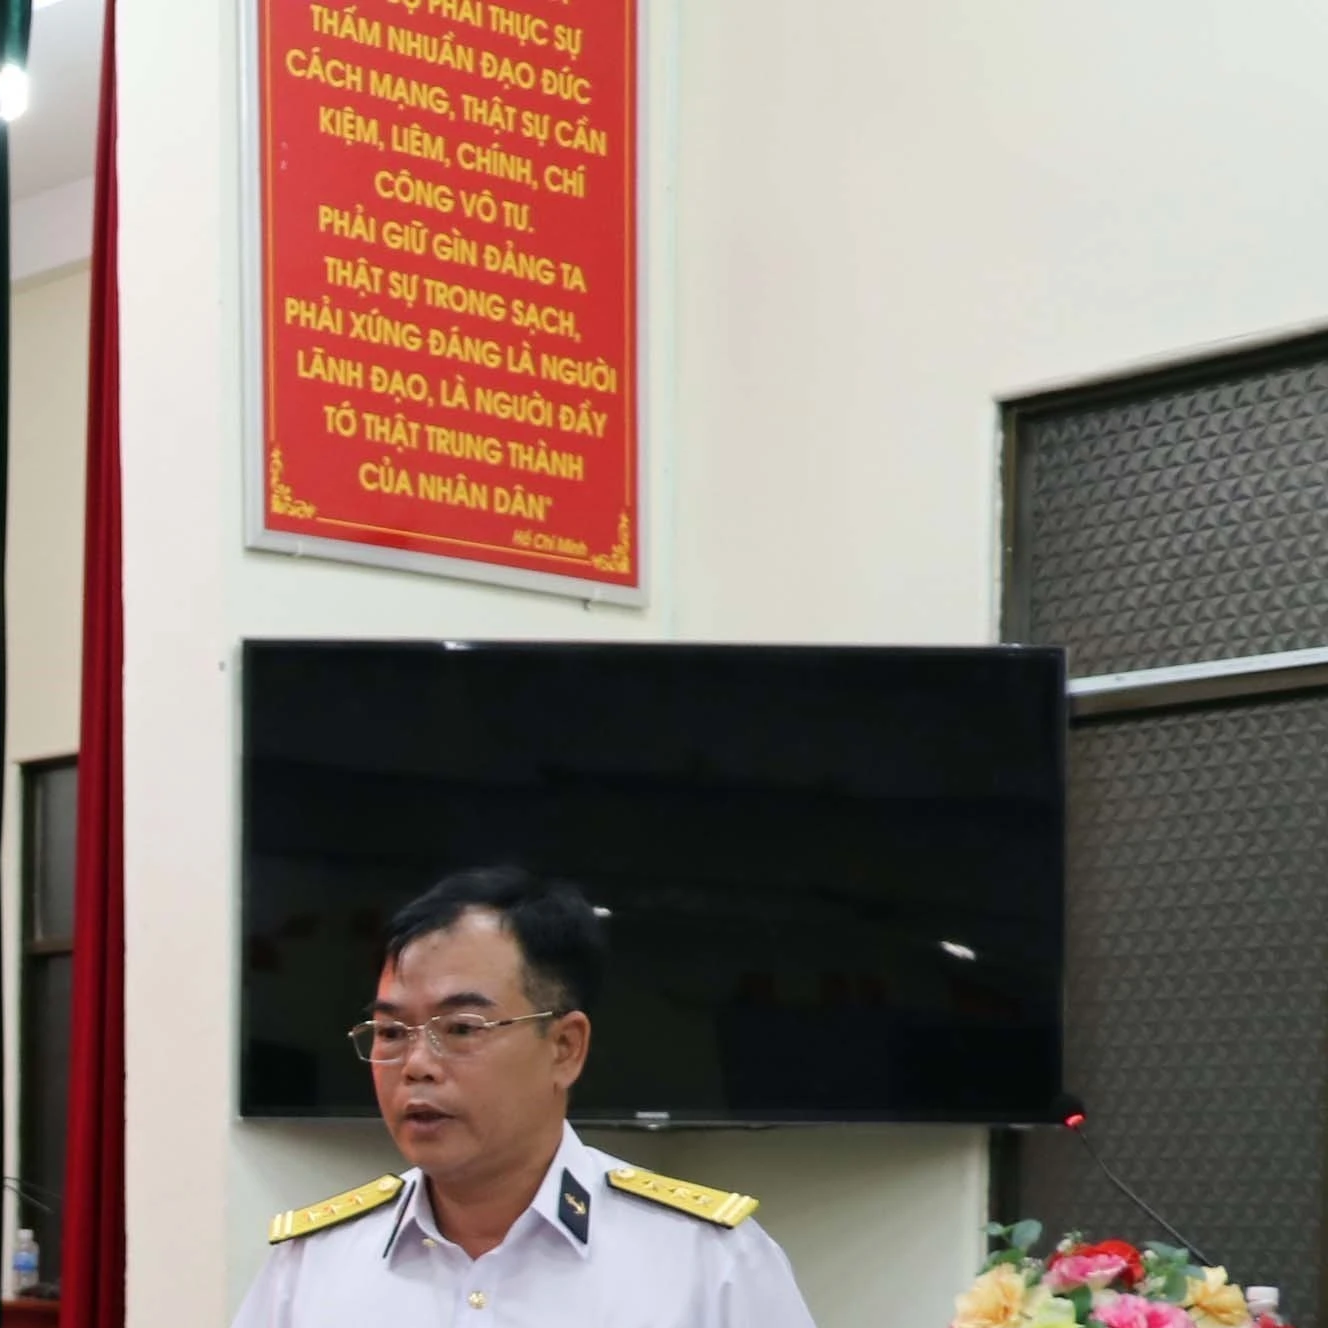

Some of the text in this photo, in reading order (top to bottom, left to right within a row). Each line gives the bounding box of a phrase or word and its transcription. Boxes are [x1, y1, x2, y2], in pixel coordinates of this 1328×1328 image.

[310, 4, 592, 105] THẤM NHUẦN ĐẠO ĐỨC
[488, 5, 549, 46] THỰC
[554, 24, 583, 60] SỰ
[286, 46, 363, 92] CÁCH
[369, 70, 456, 121] MẠNG,
[461, 95, 517, 135] THẬT
[521, 110, 550, 147] SỰ
[319, 105, 586, 198] KIỆM, LIÊM, CHÍNH, CHÍ
[374, 169, 536, 233] CÔNG VÔ TƯ.
[318, 204, 588, 294] PHẢI GIỮ GÌN ĐẢNG TA
[324, 256, 583, 344] THẬT SỰ TRONG SẠCH,
[285, 295, 618, 394] PHẢI XỨNG ĐÁNG LÀ NGƯỜI
[297, 346, 364, 389] LÃNH
[370, 365, 434, 408] ĐẠO,
[440, 374, 470, 410] LÀ
[475, 387, 553, 429] NGƯỜI
[358, 456, 414, 497] CỦA
[418, 473, 489, 511] NHÂN
[361, 412, 421, 455] THẬT
[425, 424, 503, 466] TRUNG
[508, 439, 584, 482] THÀNH
